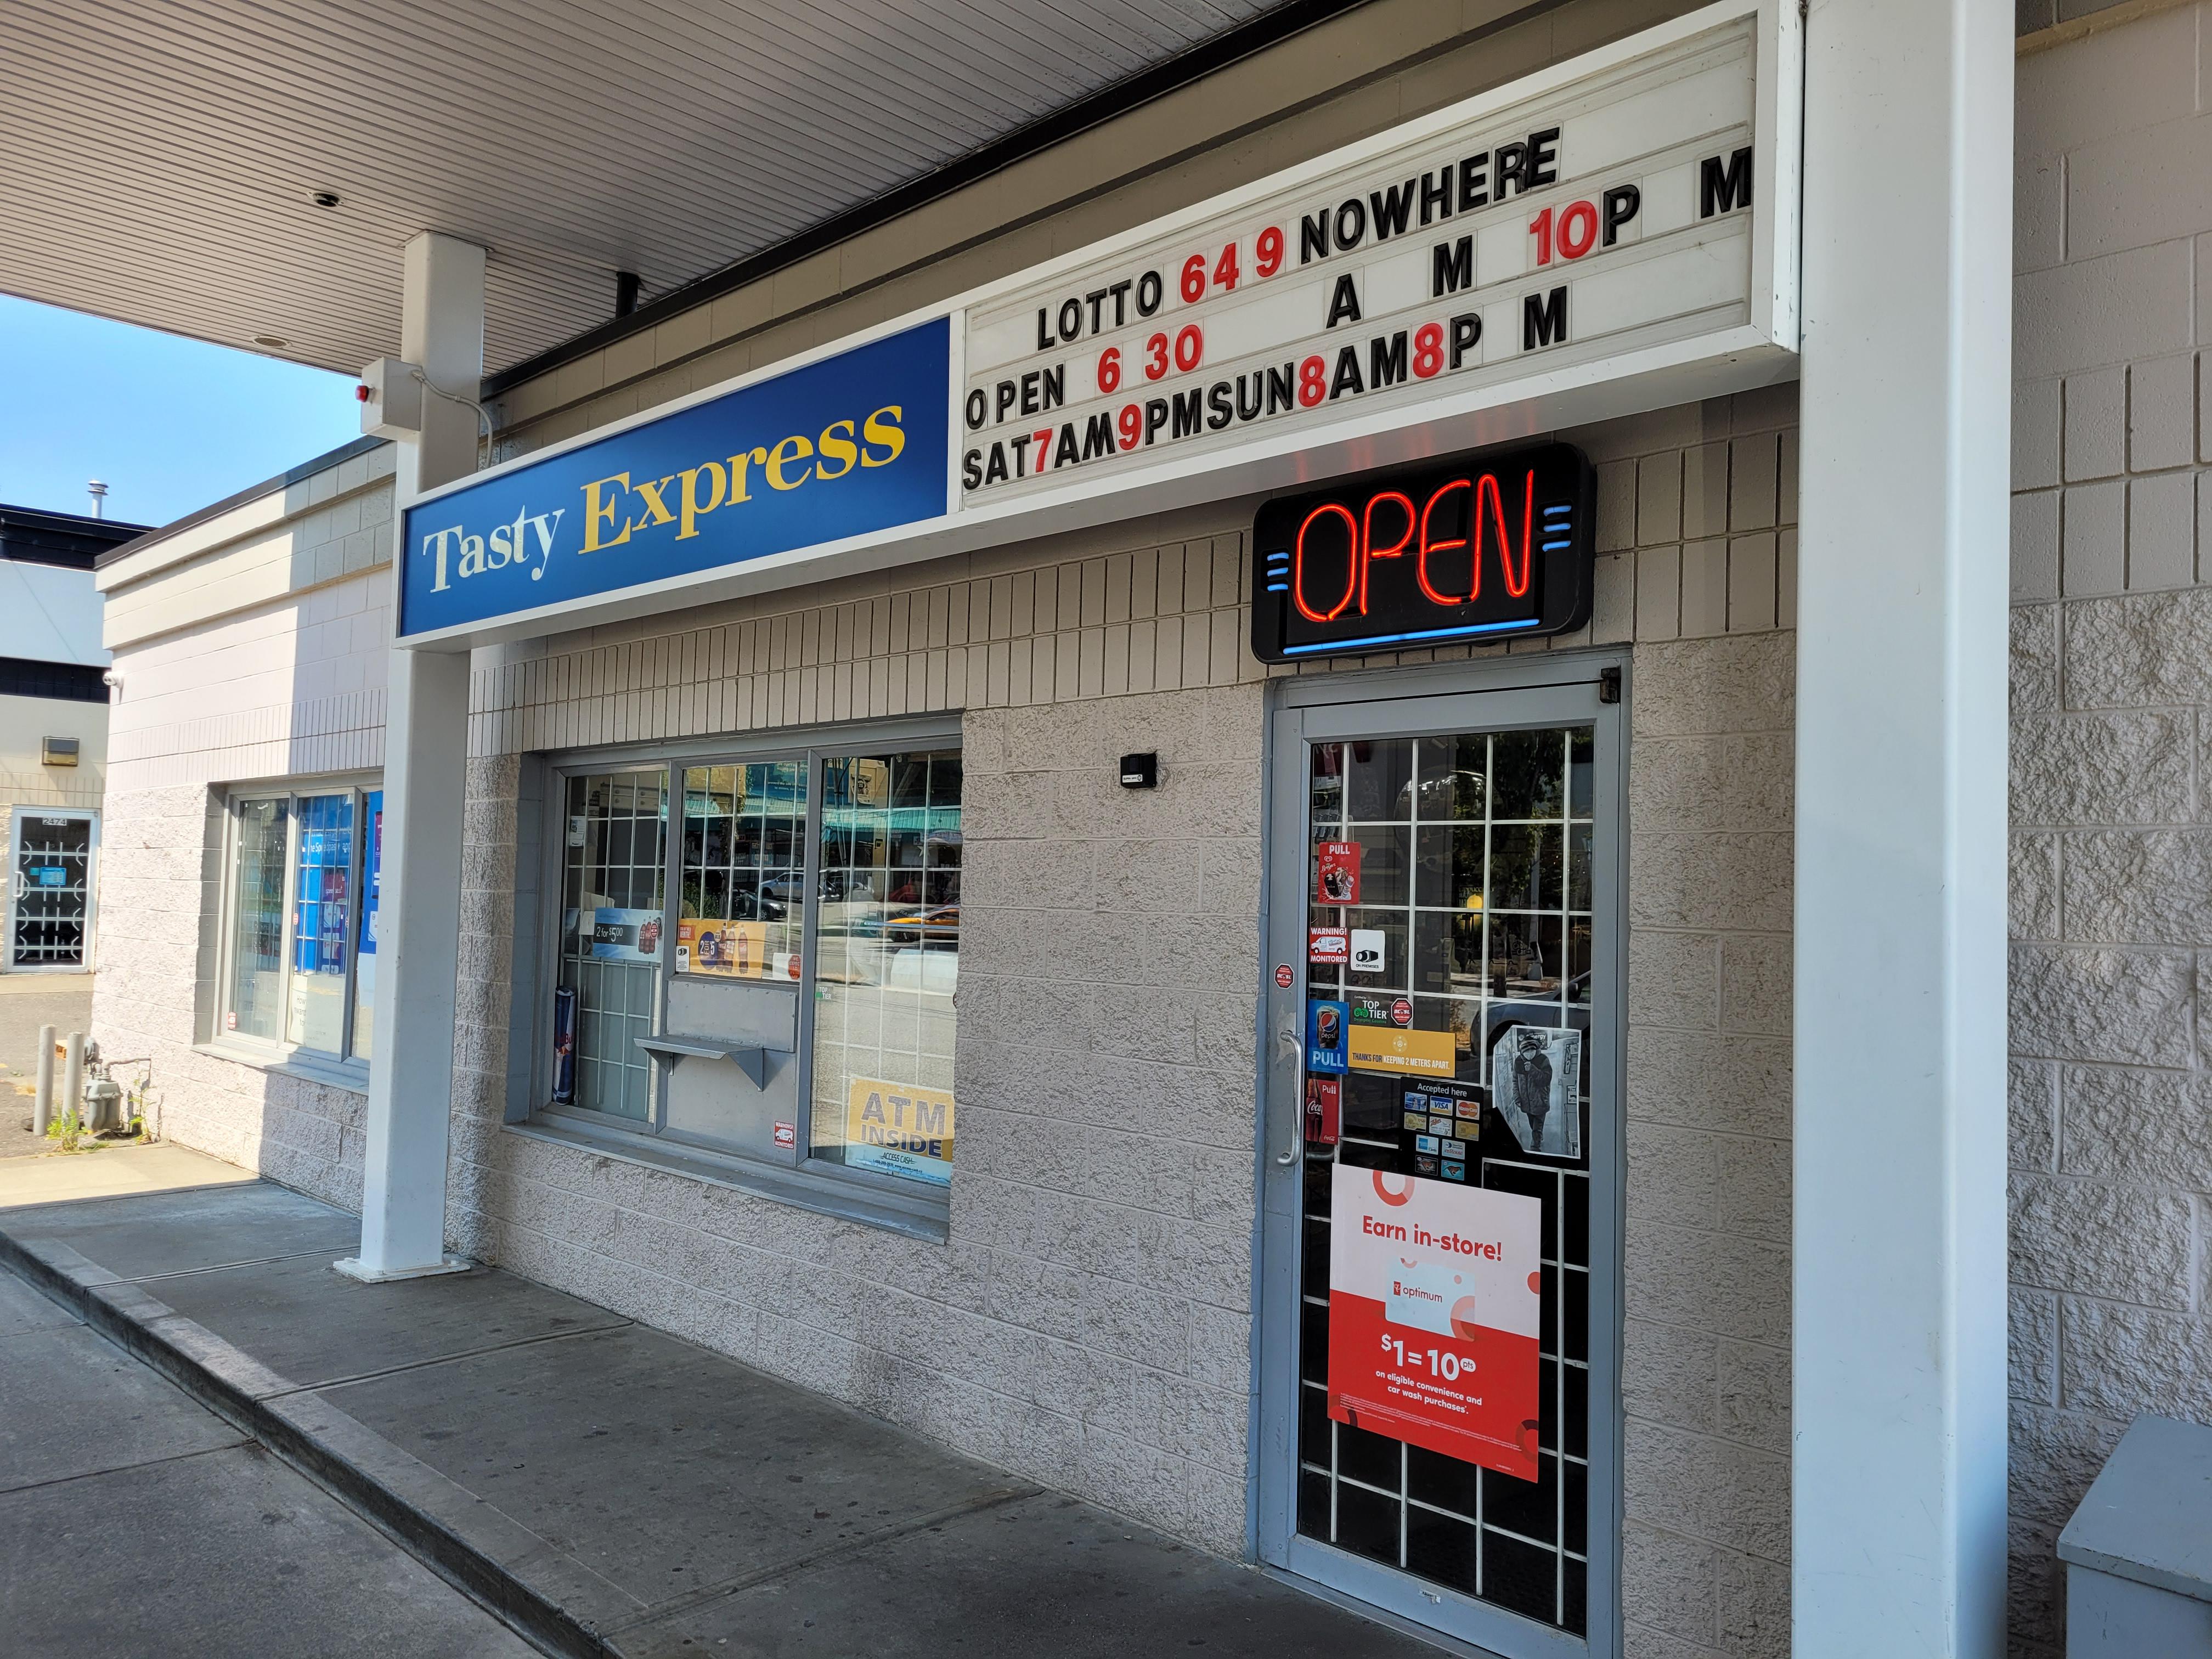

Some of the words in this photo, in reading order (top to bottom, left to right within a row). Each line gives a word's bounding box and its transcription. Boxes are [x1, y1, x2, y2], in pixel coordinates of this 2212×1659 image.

[1037, 270, 1162, 352] LOTTO
[1301, 127, 1560, 265] NOWHERE
[966, 363, 1064, 430] OPEN
[1097, 347, 1121, 393] 6
[1145, 324, 1203, 381] 30
[1326, 273, 1362, 329] A
[1433, 234, 1472, 298] M
[1701, 145, 1752, 219] M
[422, 505, 565, 594] Tasty
[578, 405, 905, 555] Express
[1293, 469, 1533, 622] OPEN
[1329, 845, 1350, 855] PULL
[596, 926, 601, 937] 2
[601, 928, 609, 938] for
[1311, 955, 1347, 963] MONITORED
[1362, 1000, 1380, 1009] TOP
[1368, 1009, 1387, 1020] TIER
[1313, 1051, 1344, 1068] PULL
[1352, 1052, 1372, 1062] THANKS
[1373, 1054, 1382, 1063] FOR
[1383, 1055, 1404, 1065] KEEPING
[1406, 1057, 1409, 1066] 2
[1410, 1058, 1431, 1068] METERS
[1431, 1059, 1451, 1070] APART.
[1322, 1085, 1336, 1094] Pull
[1417, 1082, 1449, 1094] Accepted
[1451, 1086, 1468, 1097] here
[1434, 1102, 1449, 1110] VISA
[860, 1091, 947, 1137] ATM
[775, 1121, 794, 1130] WARNING!
[775, 1141, 794, 1149] MONITORED
[861, 1124, 943, 1159] INSIDE
[882, 1152, 900, 1163] ACCESS
[1363, 1215, 1406, 1242] Earn
[1414, 1223, 1502, 1261] in-store!
[1403, 1285, 1443, 1303] optimum
[1463, 1361, 1474, 1370] pts
[1375, 1370, 1385, 1379] on
[1387, 1372, 1414, 1387] eligible
[1416, 1381, 1464, 1401] convenience
[1466, 1395, 1482, 1406] and
[1387, 1385, 1401, 1394] car
[1402, 1389, 1423, 1401] wash
